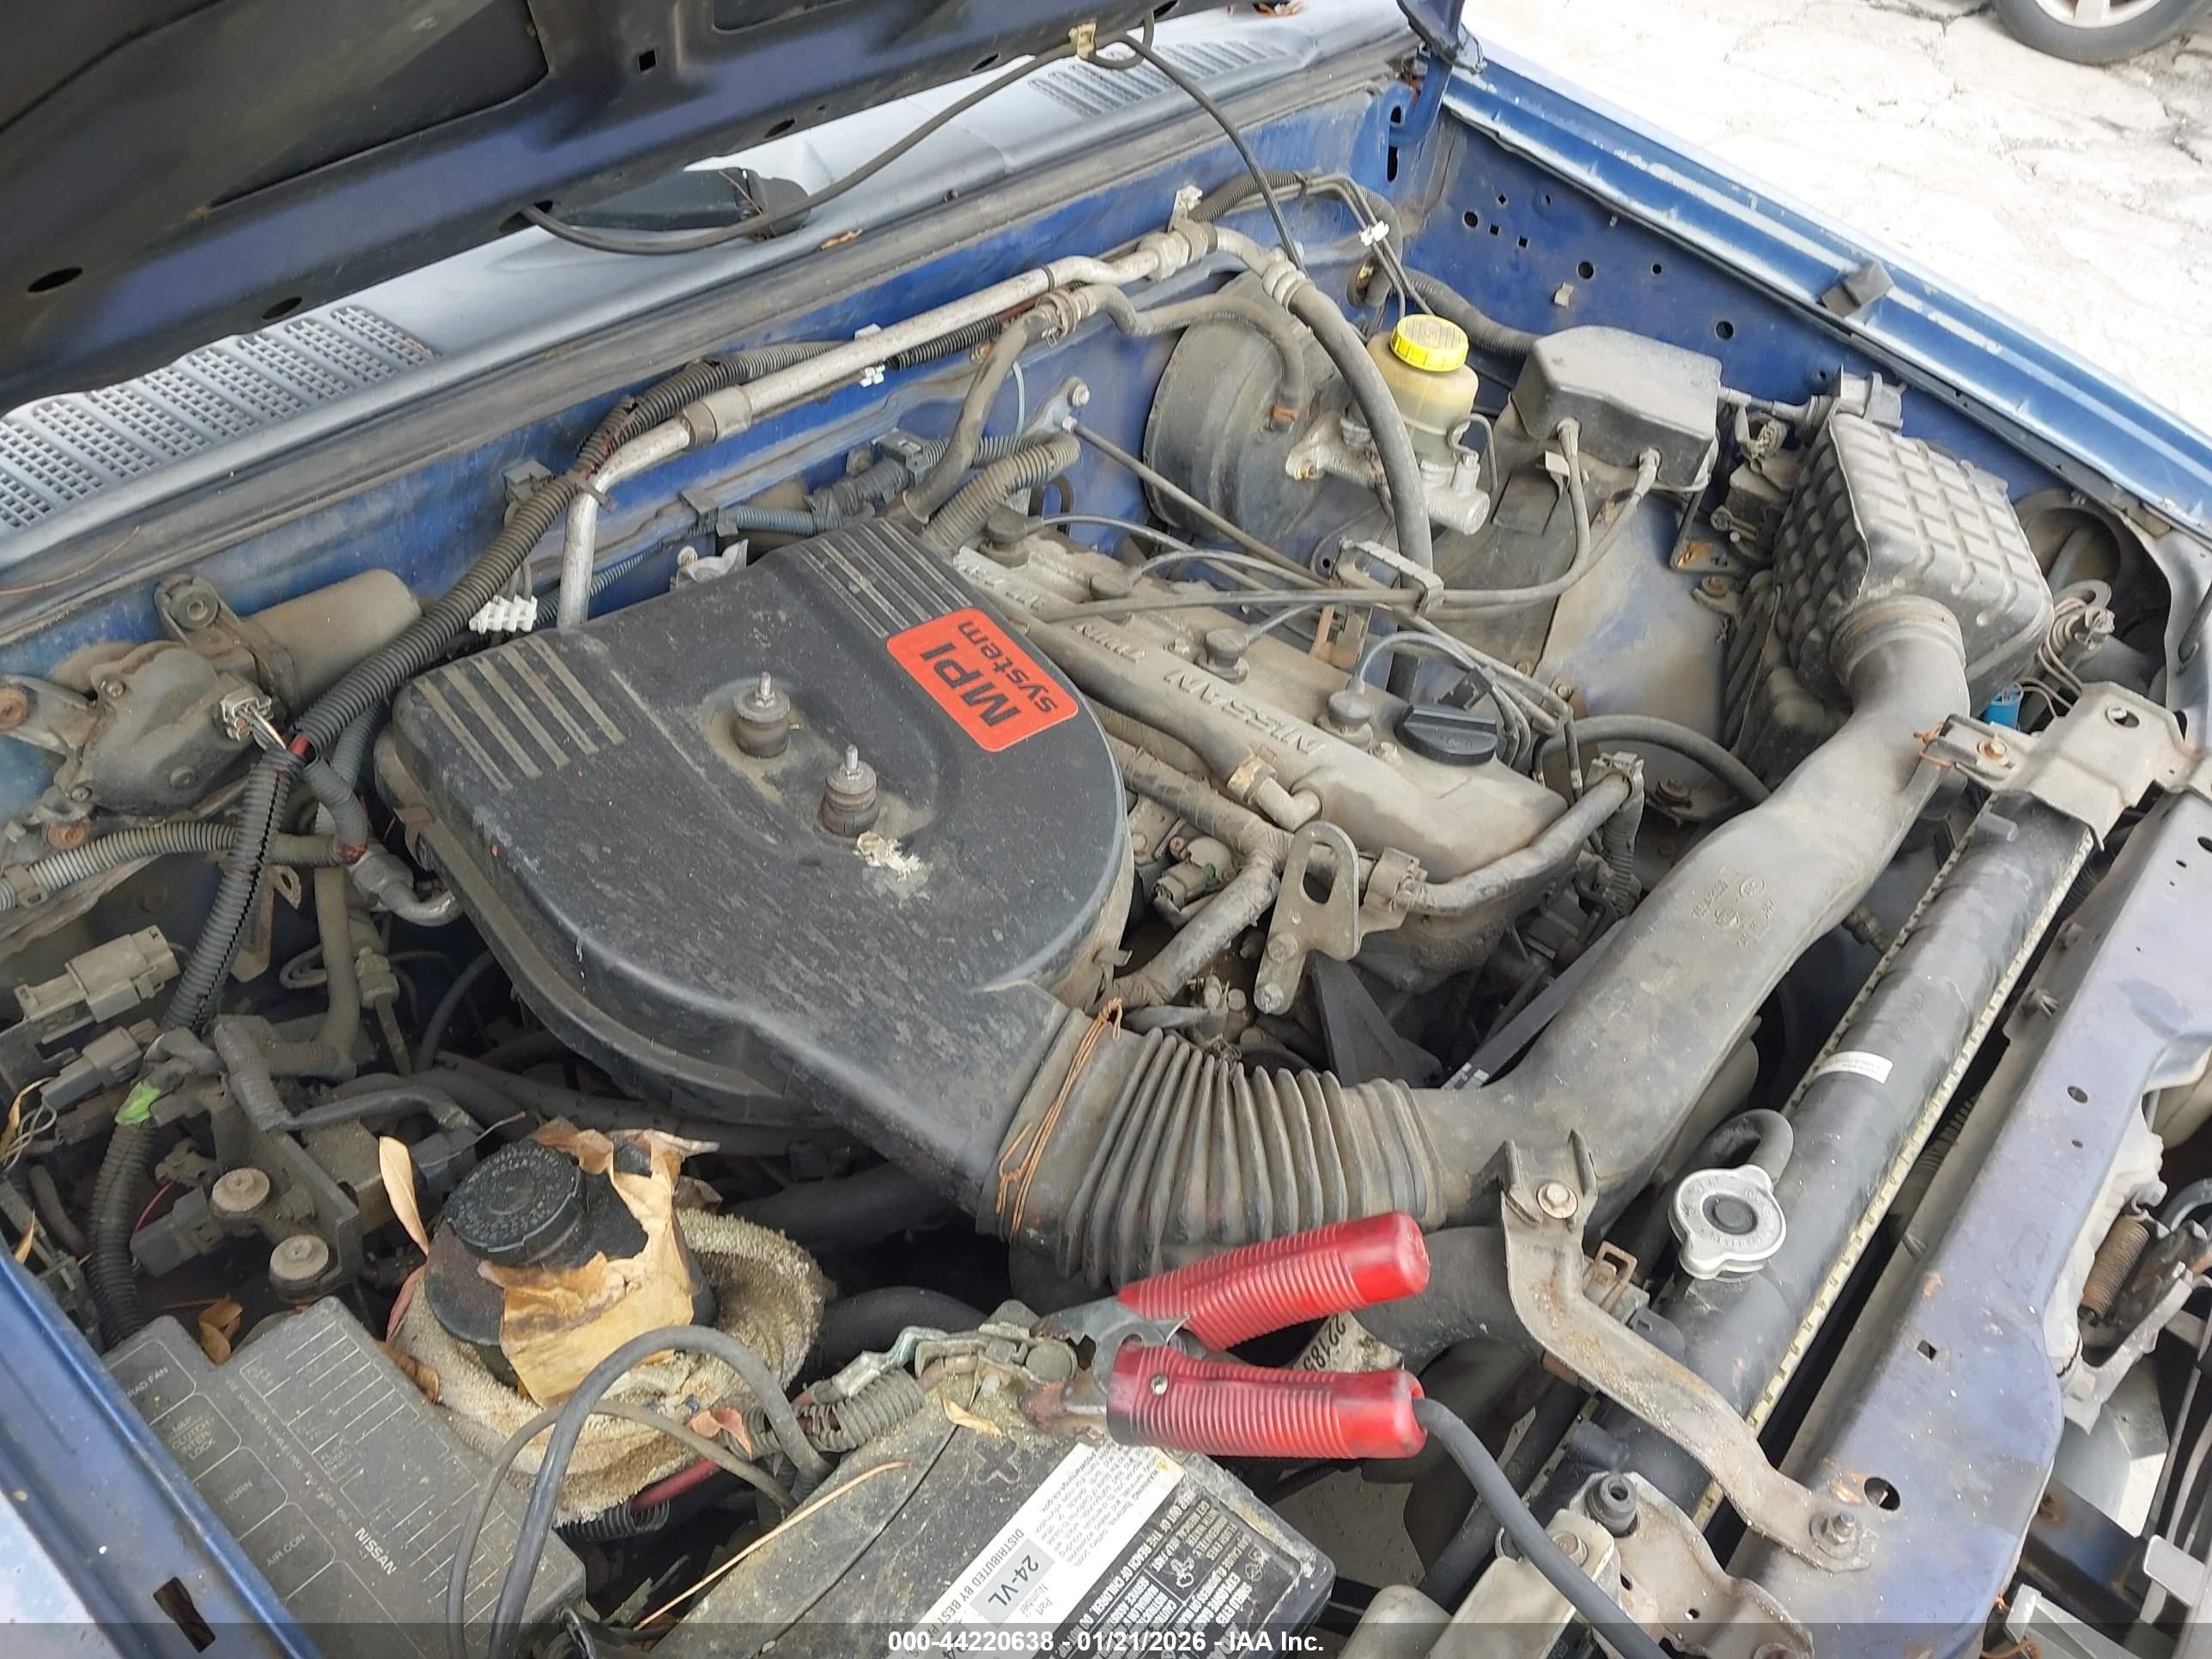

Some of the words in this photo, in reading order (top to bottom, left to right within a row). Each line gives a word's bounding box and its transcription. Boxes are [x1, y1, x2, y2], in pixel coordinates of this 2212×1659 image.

[957, 621, 1059, 714] system
[921, 641, 1022, 727] MPI
[1163, 668, 1327, 756] NISSAN
[147, 1365, 168, 1382] FAN
[222, 1480, 252, 1504] HORN
[1165, 1505, 1182, 1522] OUT
[1194, 1500, 1209, 1515] GET
[1157, 1518, 1171, 1532] OF
[1176, 1511, 1199, 1539] MEDICAL
[265, 1550, 283, 1565] AIR
[283, 1534, 306, 1553] CON
[1146, 1529, 1163, 1547] THE
[1163, 1536, 1181, 1556] HELP
[1206, 1541, 1223, 1560] EYES
[356, 1528, 395, 1574] NISSAN
[972, 1528, 1023, 1587] DISTRIBUTED
[1127, 1543, 1152, 1570] REACH
[1149, 1552, 1168, 1573] FAST.
[1221, 1547, 1242, 1570] CAUSE
[989, 1555, 1038, 1610] 24-VL
[1117, 1565, 1133, 1581] OF
[1196, 1566, 1226, 1602] BLINDNESS
[958, 1585, 974, 1601] BY
[1018, 1583, 1047, 1615] Number
[1089, 1577, 1124, 1616] CHILDREN.
[1125, 1577, 1148, 1604] SERVICE
[1134, 1584, 1158, 1612] MANUAL
[1207, 1572, 1240, 1611] EXPLOSIVE
[1228, 1582, 1252, 1608] SHIELD
[937, 1599, 961, 1626] BEST
[1035, 1596, 1053, 1616] Part
[1126, 1607, 1140, 1622] OR
[1188, 1599, 1202, 1612] OR
[1214, 1604, 1236, 1627] EYES
[1078, 1613, 1094, 1630] DO
